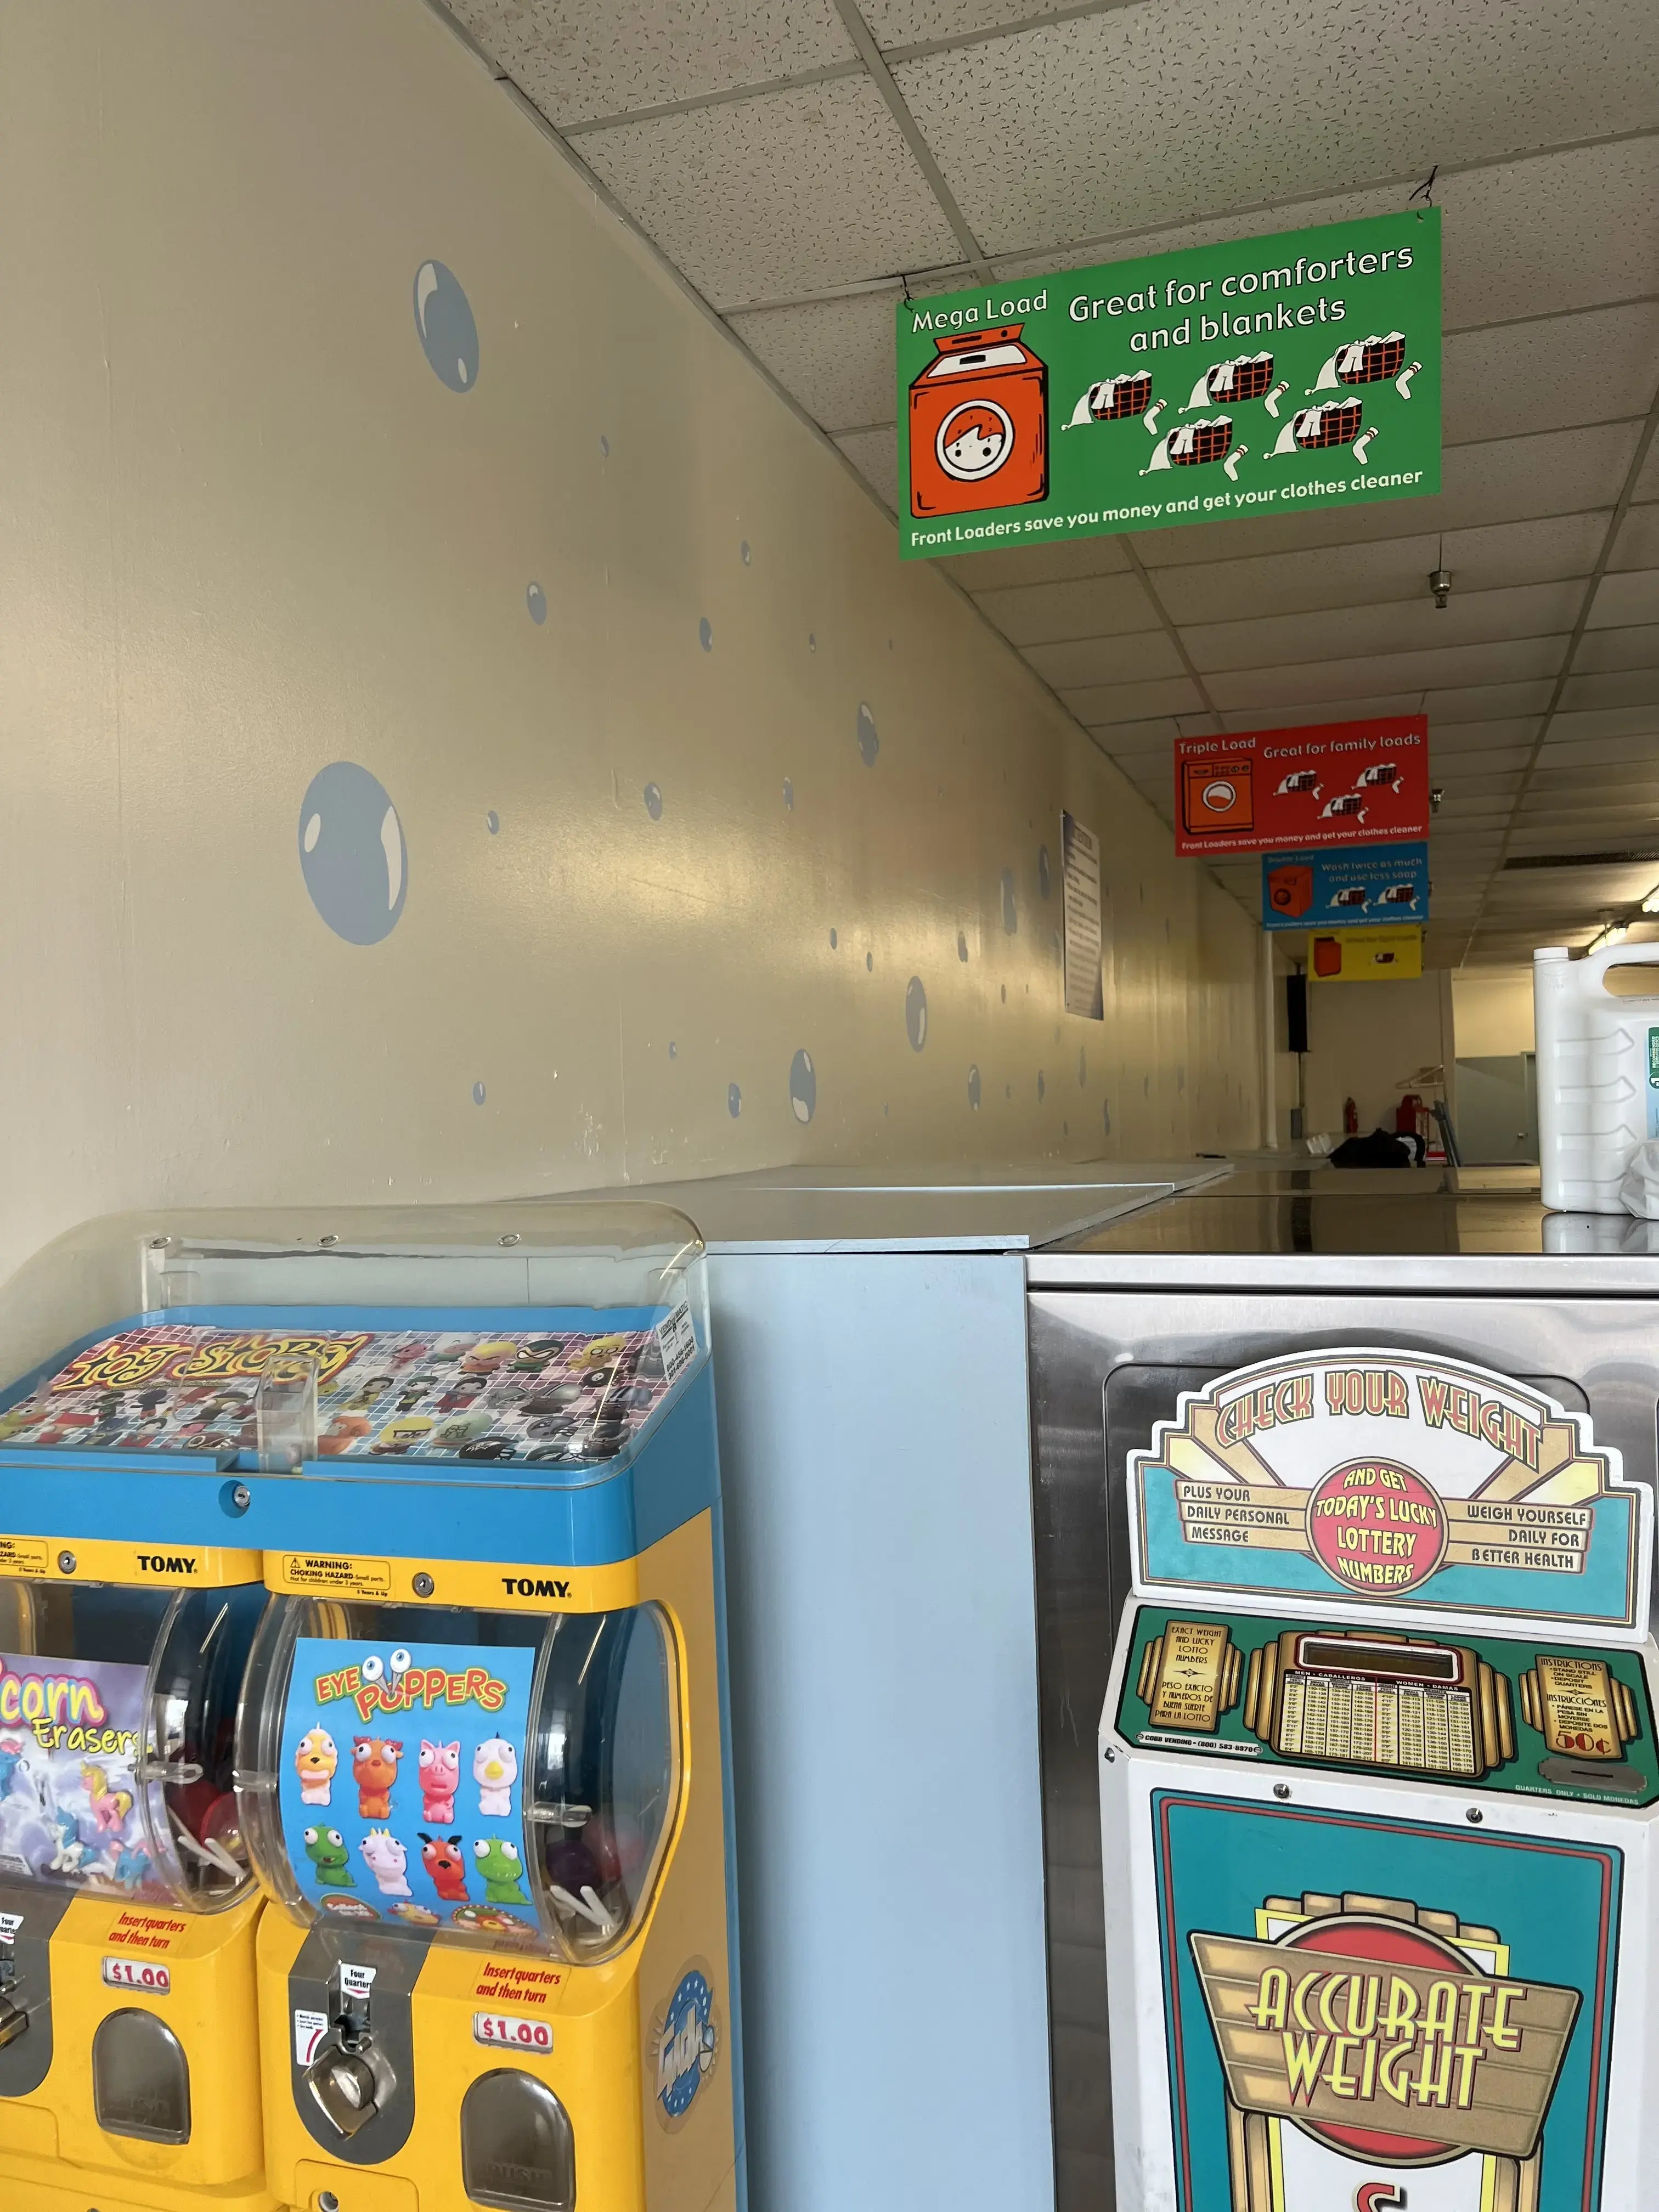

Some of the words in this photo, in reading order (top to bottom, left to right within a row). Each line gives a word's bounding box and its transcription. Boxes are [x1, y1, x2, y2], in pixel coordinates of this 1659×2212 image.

[1068, 286, 1156, 323] Great
[1165, 276, 1212, 307] for
[1221, 246, 1414, 298] comforters
[912, 307, 979, 333] Mega
[986, 289, 1048, 320] Load
[1130, 319, 1190, 353] and
[1200, 297, 1347, 343] blankets
[911, 529, 952, 548] Front
[955, 520, 1022, 543] Loaders
[1024, 517, 1064, 534] save
[1068, 512, 1098, 529] you
[1103, 503, 1163, 525] money
[1166, 495, 1199, 514] and
[1203, 492, 1231, 512] get
[1234, 488, 1277, 507] your
[1280, 479, 1347, 500] clothes
[1351, 469, 1423, 491] cleaner
[1179, 741, 1218, 755] Triple
[1221, 737, 1256, 751] Load
[1263, 746, 1302, 759] Great
[1306, 742, 1327, 755] for
[1330, 737, 1376, 752] family
[1380, 733, 1421, 747] loads
[1204, 839, 1236, 848] Loaders
[1259, 837, 1274, 845] you
[1275, 834, 1303, 844] money
[1322, 832, 1335, 840] get
[1336, 830, 1356, 839] your
[1358, 827, 1389, 836] clothes
[1390, 825, 1422, 833] cleaner
[1321, 862, 1349, 871] Wash
[1351, 861, 1378, 870] twice
[1394, 857, 1422, 866] much
[1328, 874, 1348, 883] and
[1216, 1375, 1313, 1448] CHECK
[1326, 1370, 1409, 1418] YOUR
[1417, 1375, 1542, 1472] WEIGHT
[1343, 1467, 1376, 1490] AND
[1379, 1469, 1407, 1492] GET
[1183, 1485, 1212, 1499] PLUS
[1216, 1487, 1251, 1502] YOUR
[1187, 1506, 1221, 1520] DAILY
[1224, 1508, 1290, 1525] PERSONAL
[1316, 1494, 1386, 1520] TODAY'S
[1389, 1499, 1437, 1527] LUCKY
[1466, 1505, 1513, 1522] WEIGH
[1517, 1507, 1587, 1526] YOURSELF
[1191, 1527, 1249, 1542] MESSAGE
[1337, 1527, 1417, 1556] LOTTERY
[1508, 1528, 1548, 1544] DAILY
[1553, 1531, 1579, 1546] FOR
[306, 1560, 352, 1570] WARNING:
[1471, 1548, 1520, 1565] BETTER
[1524, 1550, 1574, 1568] HEALTH
[1339, 1560, 1414, 1585] NUMBERS
[1172, 1627, 1193, 1635] EXACT
[1197, 1629, 1222, 1637] WEIGHT
[1193, 1638, 1215, 1646] LUCKY
[1176, 1655, 1207, 1663] NUMBERS
[1178, 1645, 1208, 1654] LOTTO
[1541, 1658, 1602, 1671] INSTRUCTIONS
[316, 1667, 360, 1702] EYE
[354, 1667, 507, 1722] POPPERS
[1163, 1690, 1166, 1698] Y
[1185, 1684, 1212, 1692] EXACTO
[1555, 1681, 1592, 1689] QUARTERS
[0, 1672, 106, 1726] corn
[1163, 1701, 1182, 1709] BUENA
[1185, 1703, 1205, 1712] SUERTE
[1183, 1712, 1210, 1722] LOTTO
[32, 1717, 154, 1755] Erasers
[1556, 1730, 1611, 1754] 50¢
[1219, 1743, 1253, 1752] 583-8970
[1516, 1785, 1552, 1794] QUARTERS
[1604, 1796, 1639, 1805] MONEDAS
[109, 1930, 126, 1944] and
[128, 1932, 149, 1947] then
[149, 1937, 170, 1949] turn
[112, 1962, 169, 1988] $1.00
[345, 1977, 372, 1989] Quarter
[351, 1969, 365, 1979] Four
[476, 1982, 496, 1997] and
[498, 1984, 522, 2001] then
[523, 1989, 547, 2004] turn
[1246, 1966, 1527, 2052] ACCURATE
[483, 2017, 549, 2047] $1.00
[1283, 2030, 1487, 2110] WEIGHT
